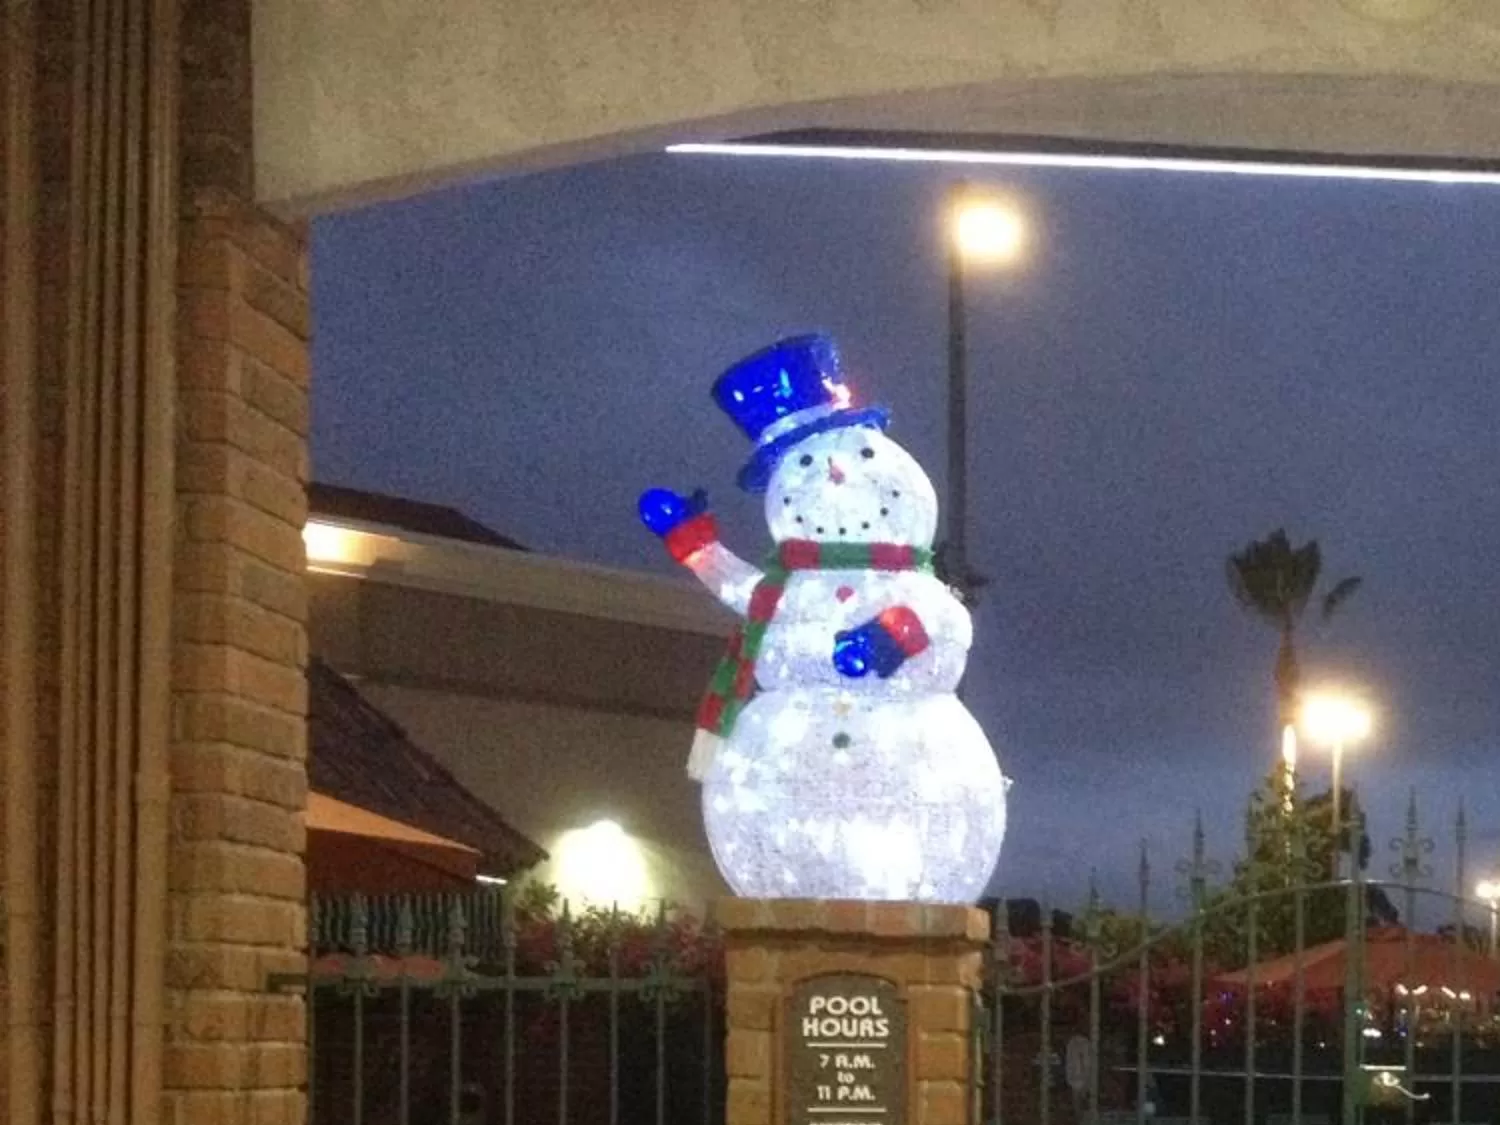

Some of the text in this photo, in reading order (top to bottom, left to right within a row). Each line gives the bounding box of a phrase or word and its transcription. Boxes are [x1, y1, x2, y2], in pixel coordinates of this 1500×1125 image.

[809, 995, 883, 1015] POOL
[802, 1017, 890, 1037] HOURS
[819, 1053, 876, 1068] 7 A.M.
[837, 1071, 856, 1083] to
[817, 1085, 877, 1100] 11 P.M.
